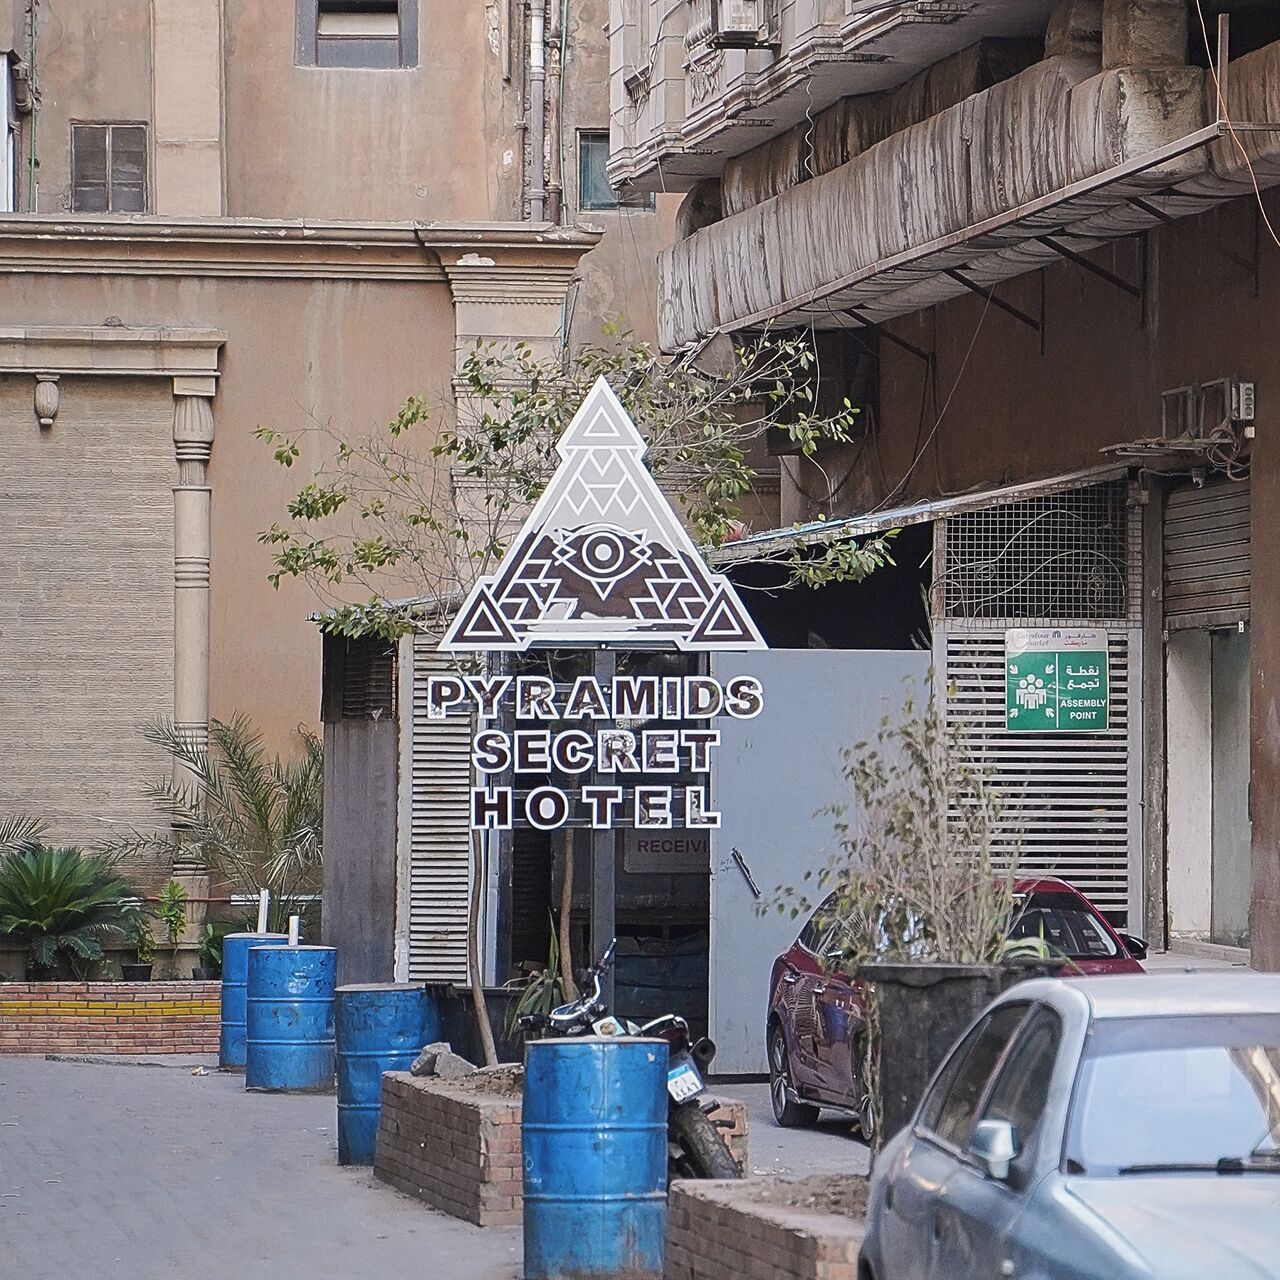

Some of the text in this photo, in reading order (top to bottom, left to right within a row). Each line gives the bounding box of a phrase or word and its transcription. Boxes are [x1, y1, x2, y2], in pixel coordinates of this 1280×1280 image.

[1066, 664, 1100, 676] نقطة
[1067, 678, 1100, 691] تجمع
[427, 675, 764, 719] PYRAMIDS
[1060, 699, 1106, 708] ASSEMBLY
[1069, 711, 1097, 720] POINT
[472, 728, 721, 774] SECRET
[470, 785, 722, 830] HOTEL
